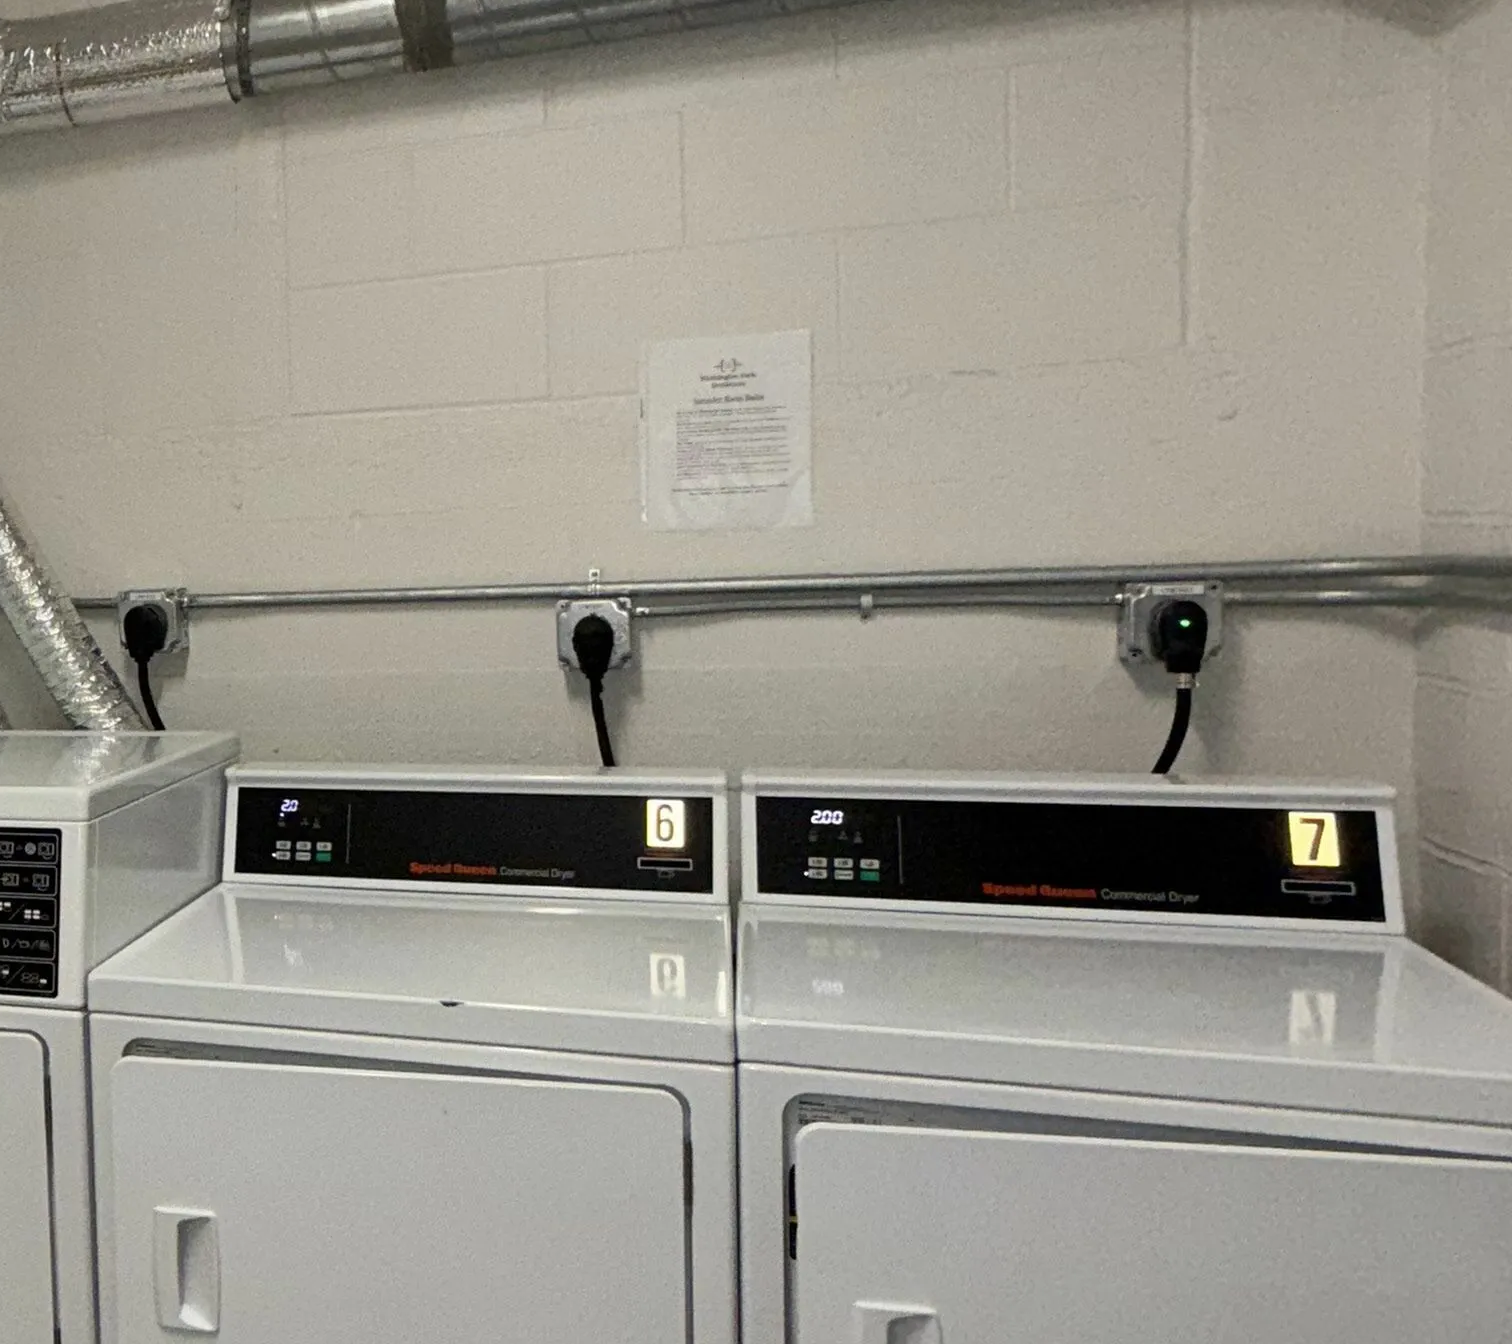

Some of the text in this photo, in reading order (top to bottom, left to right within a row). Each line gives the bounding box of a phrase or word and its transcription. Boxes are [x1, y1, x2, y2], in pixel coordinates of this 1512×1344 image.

[281, 799, 299, 812] 20
[656, 804, 674, 842] 6
[1299, 818, 1326, 861] 7
[409, 862, 576, 881] Speed Queen Commercial Dryer
[982, 883, 1200, 905] Speed Queen Commercial Dryer
